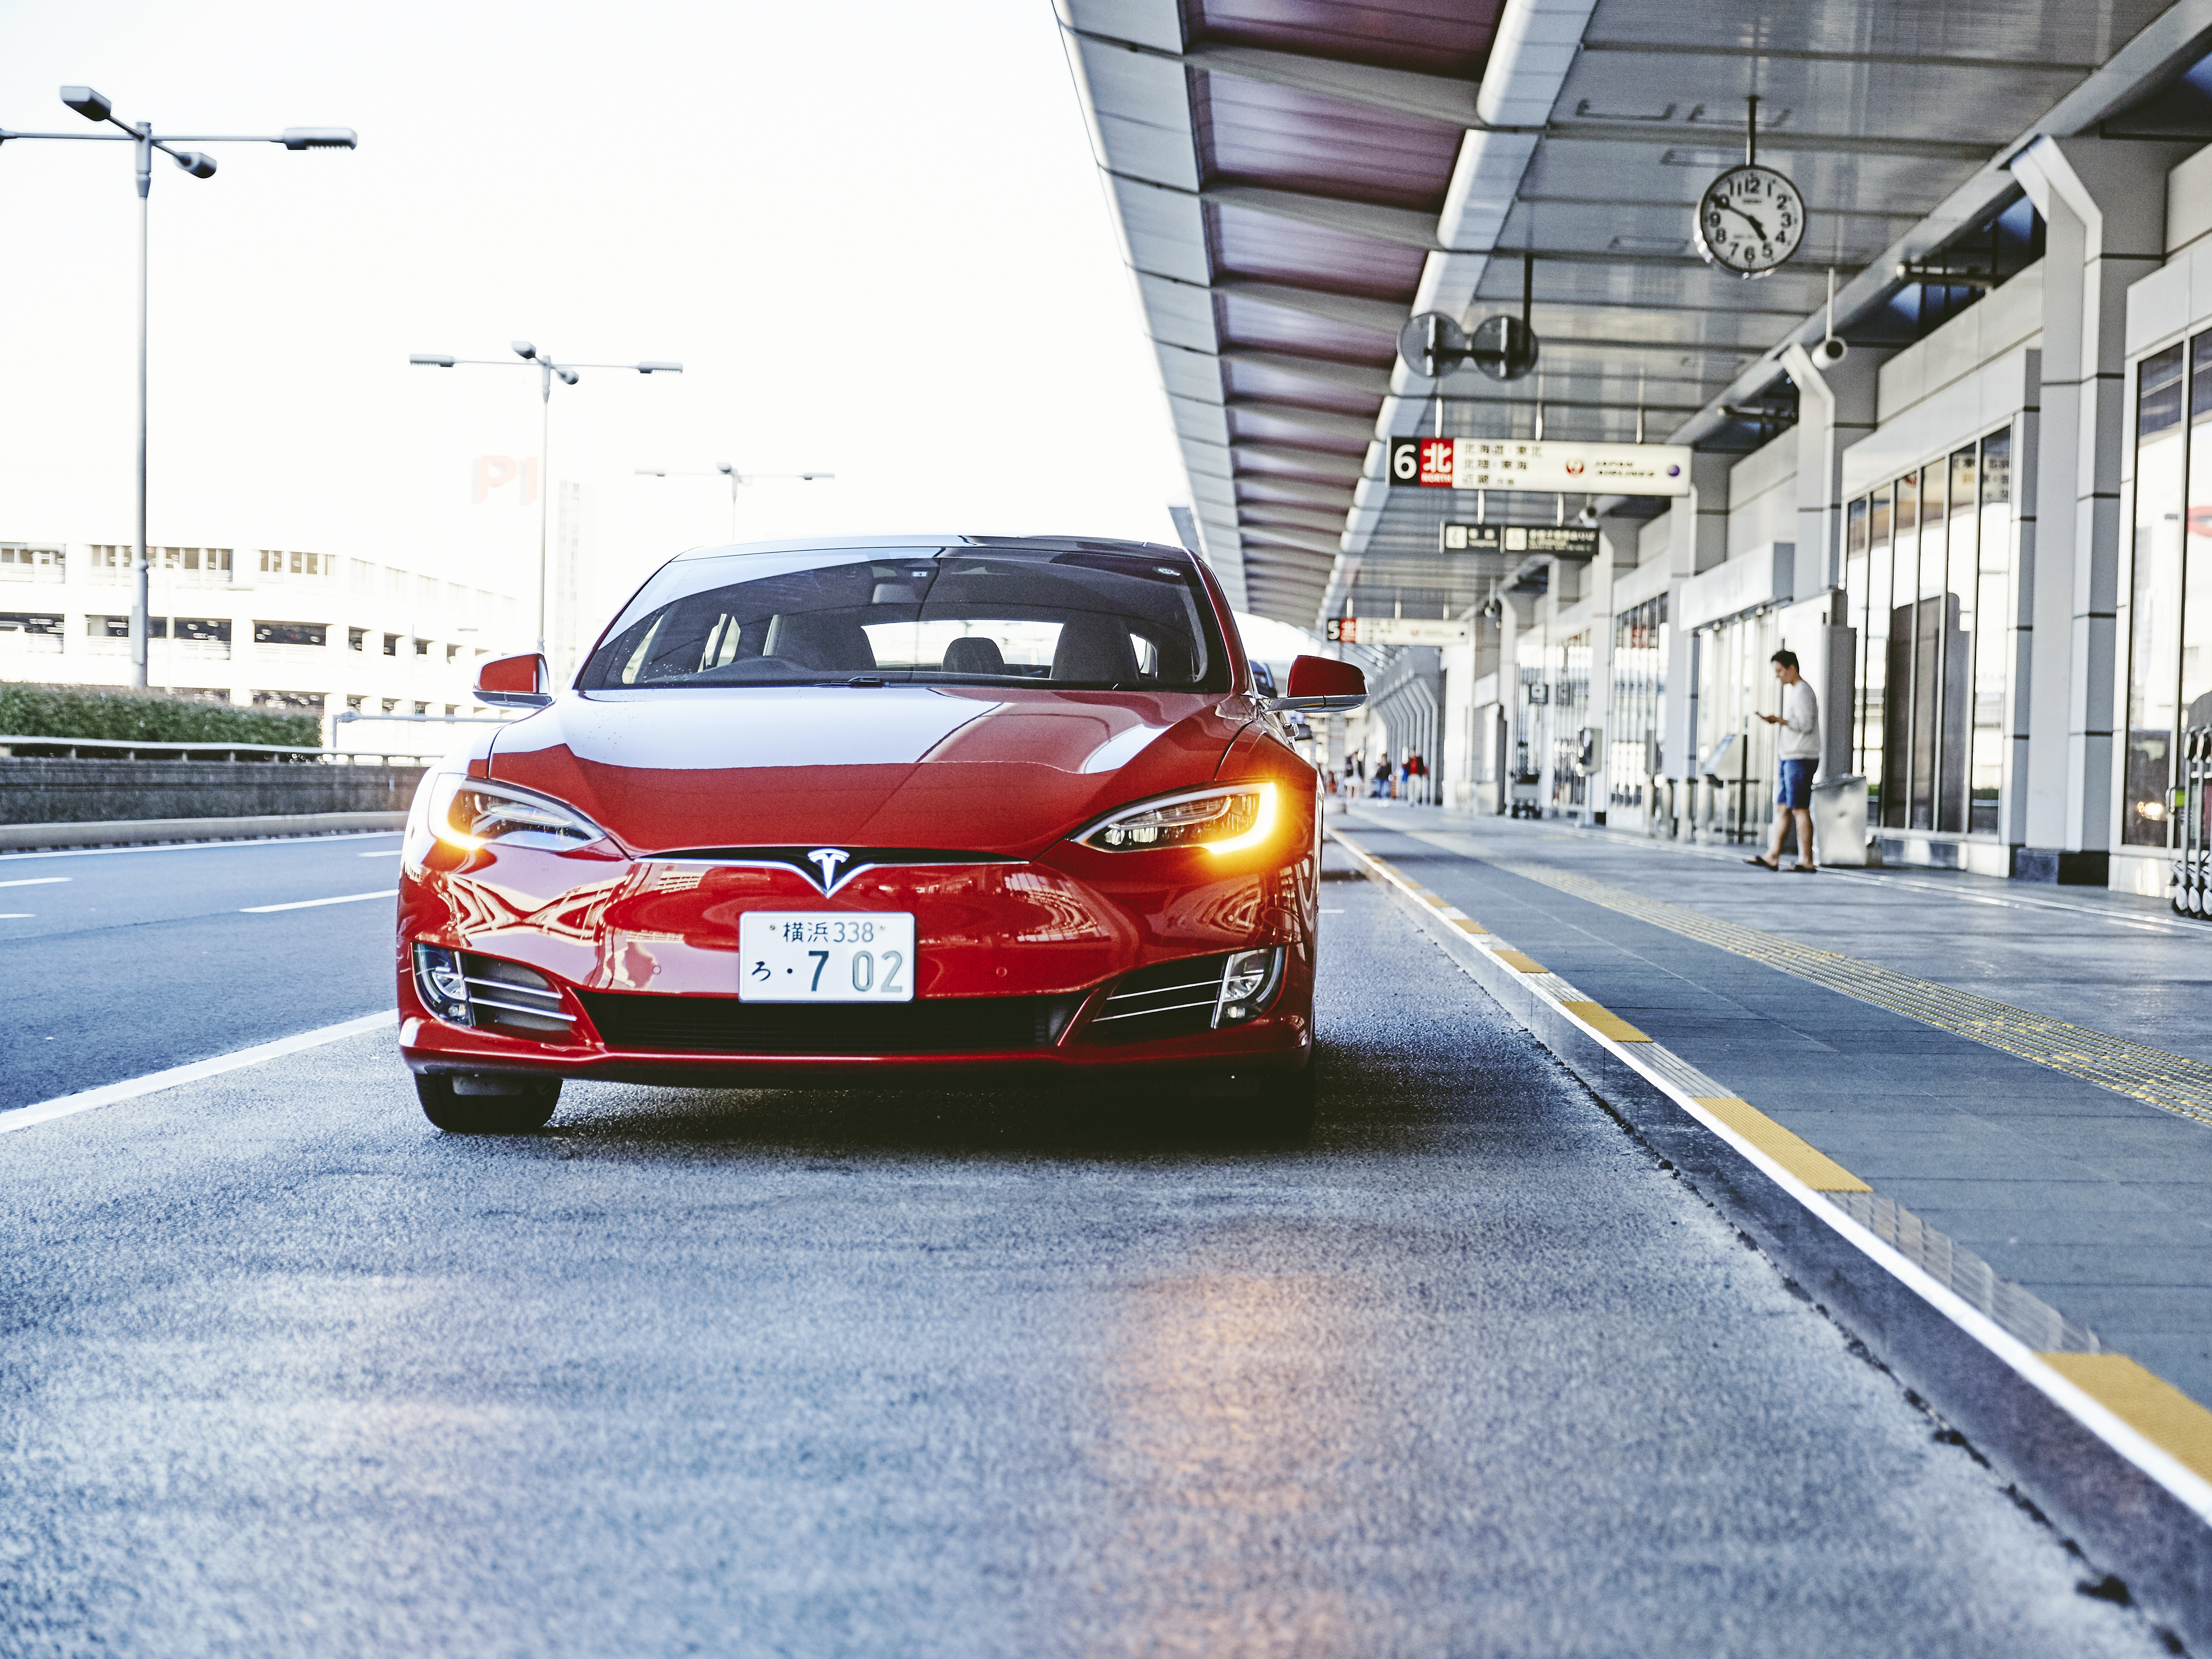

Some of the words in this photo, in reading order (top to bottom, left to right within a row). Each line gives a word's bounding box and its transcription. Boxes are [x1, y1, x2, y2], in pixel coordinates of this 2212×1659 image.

[1728, 177, 1742, 196] 11
[1745, 177, 1760, 193] 12
[1777, 194, 1787, 209] 2
[1709, 212, 1721, 227] 9
[1781, 212, 1792, 228] 3
[1715, 228, 1727, 244] 8
[1775, 230, 1785, 243] 4
[1730, 242, 1739, 256] 7
[1744, 246, 1755, 262] 6
[1762, 242, 1773, 257] 5
[1394, 444, 1417, 479] 6
[1423, 442, 1452, 473] 北
[1327, 620, 1340, 640] 5
